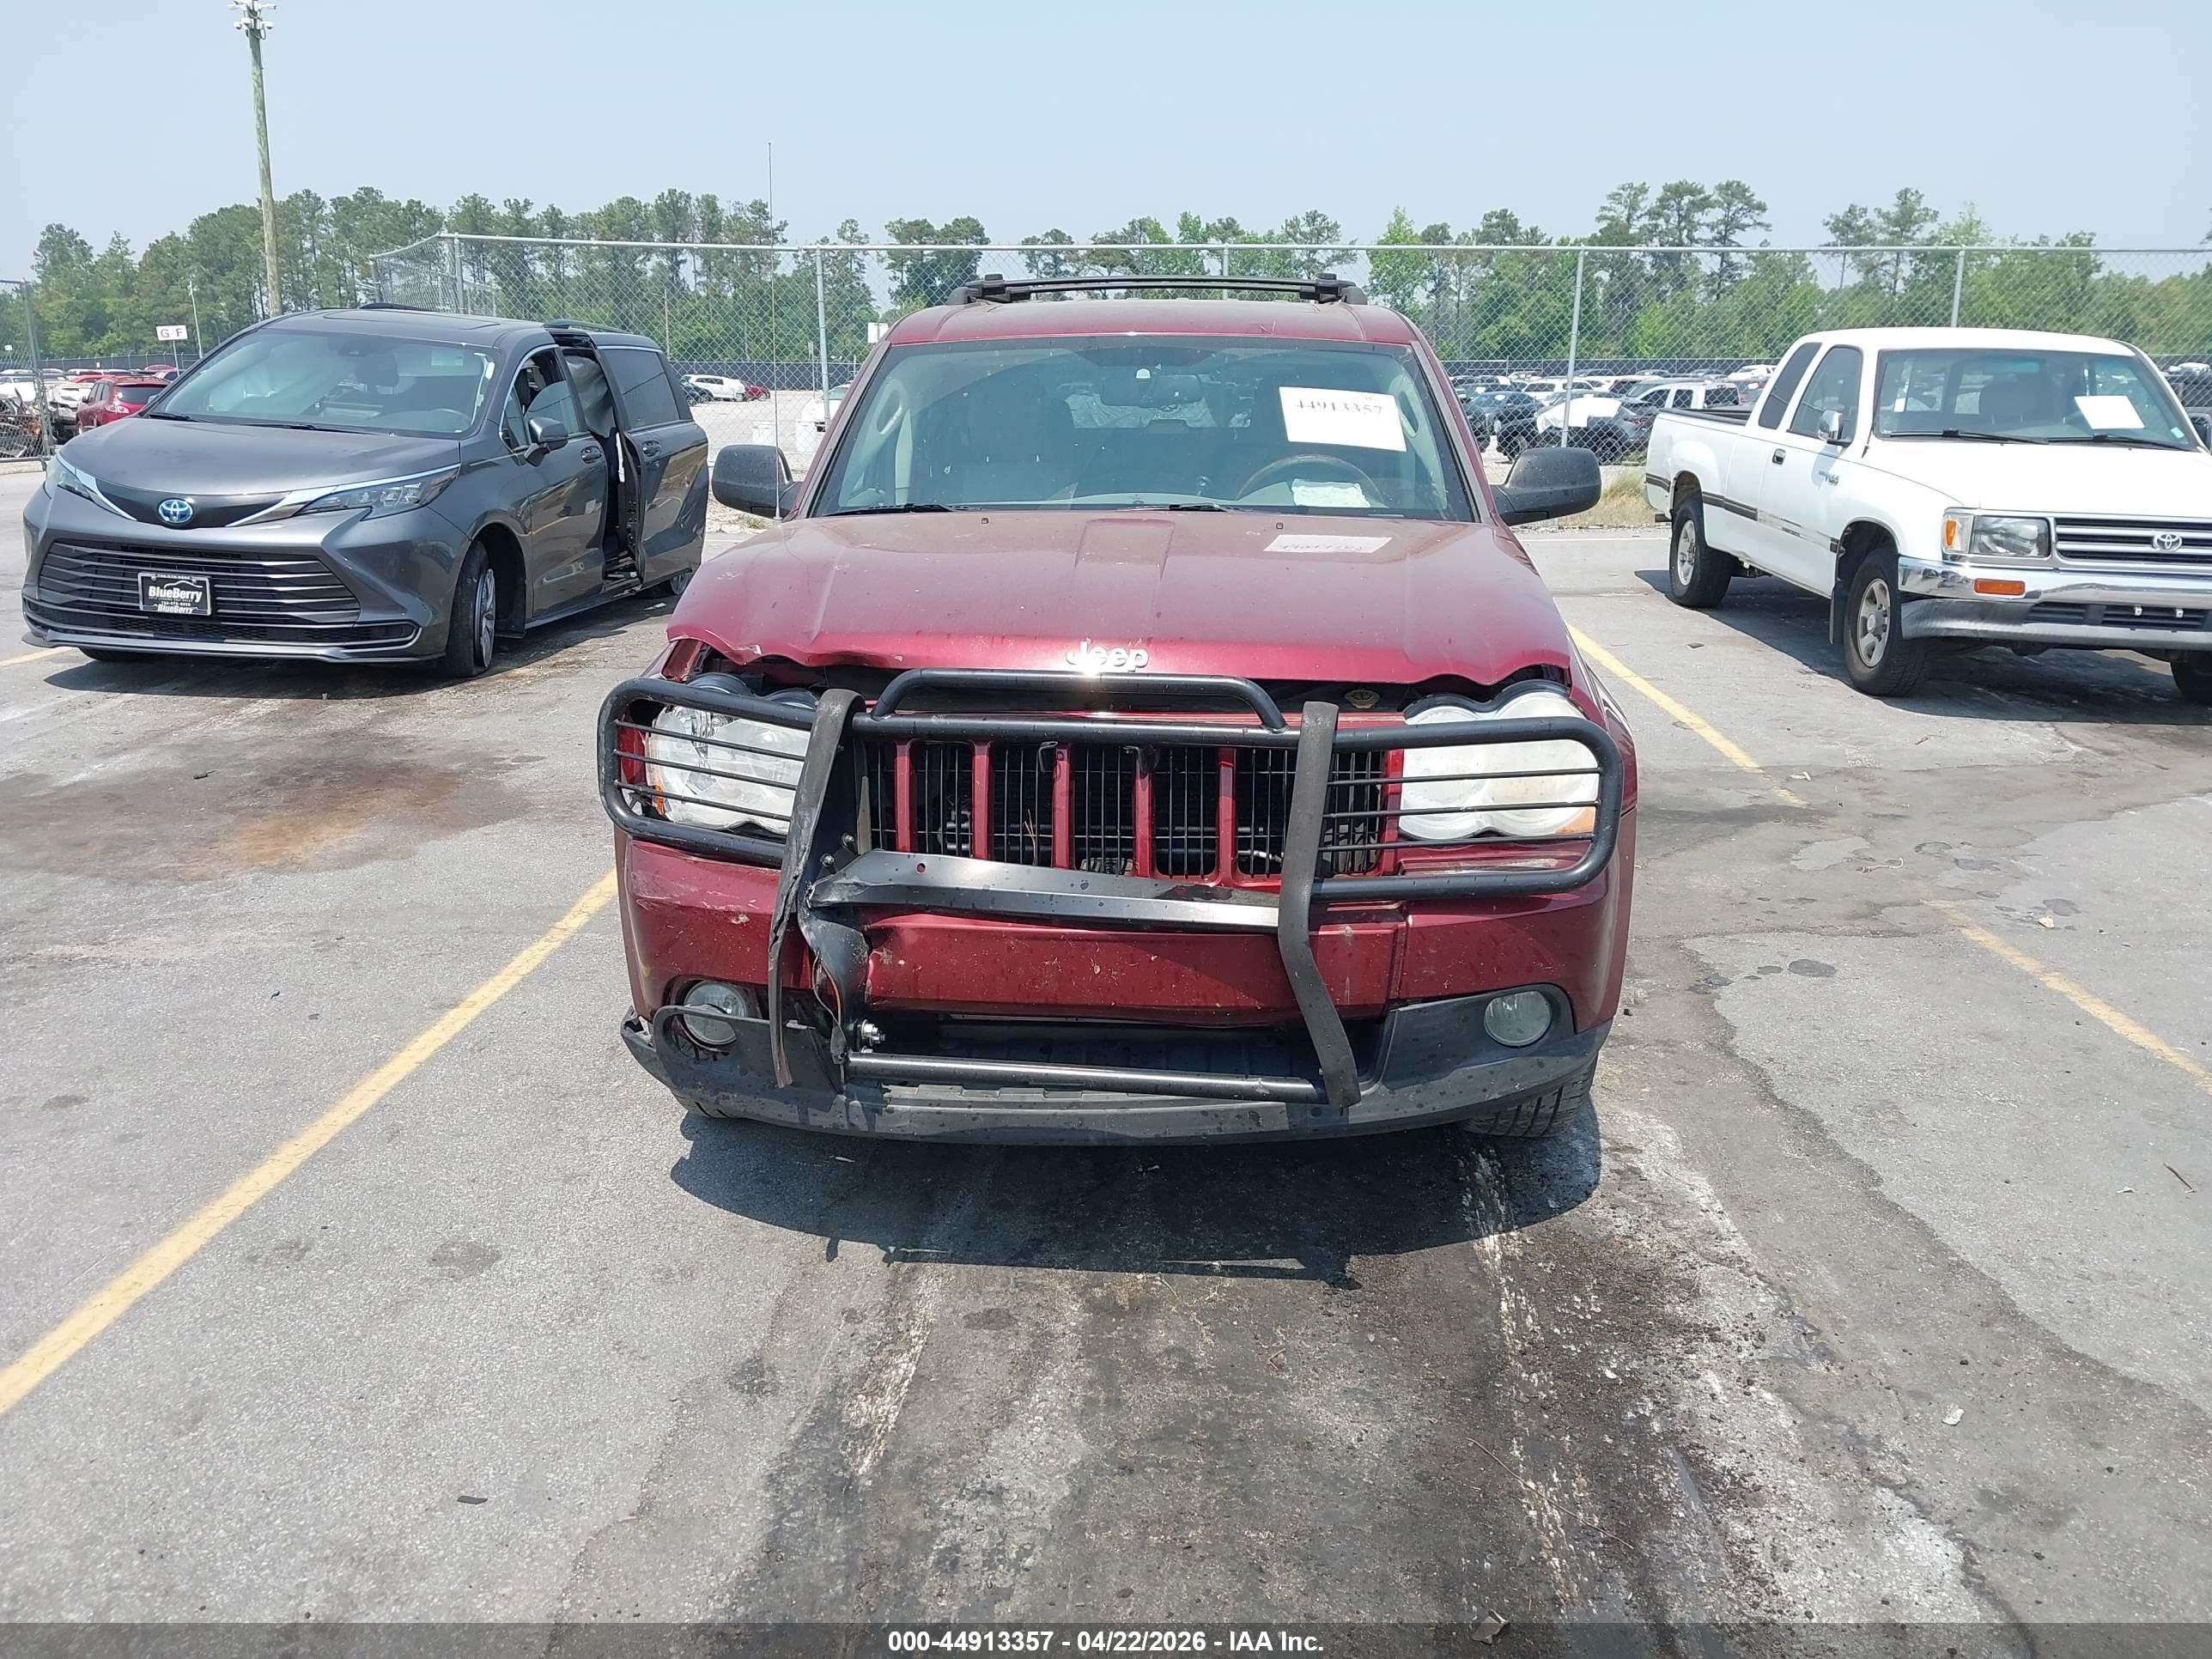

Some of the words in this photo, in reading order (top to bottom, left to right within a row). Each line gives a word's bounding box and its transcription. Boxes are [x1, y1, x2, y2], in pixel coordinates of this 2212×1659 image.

[160, 328, 170, 338] G
[175, 328, 183, 337] F
[148, 586, 203, 603] BlueBerry
[1066, 641, 1149, 673] Jeep
